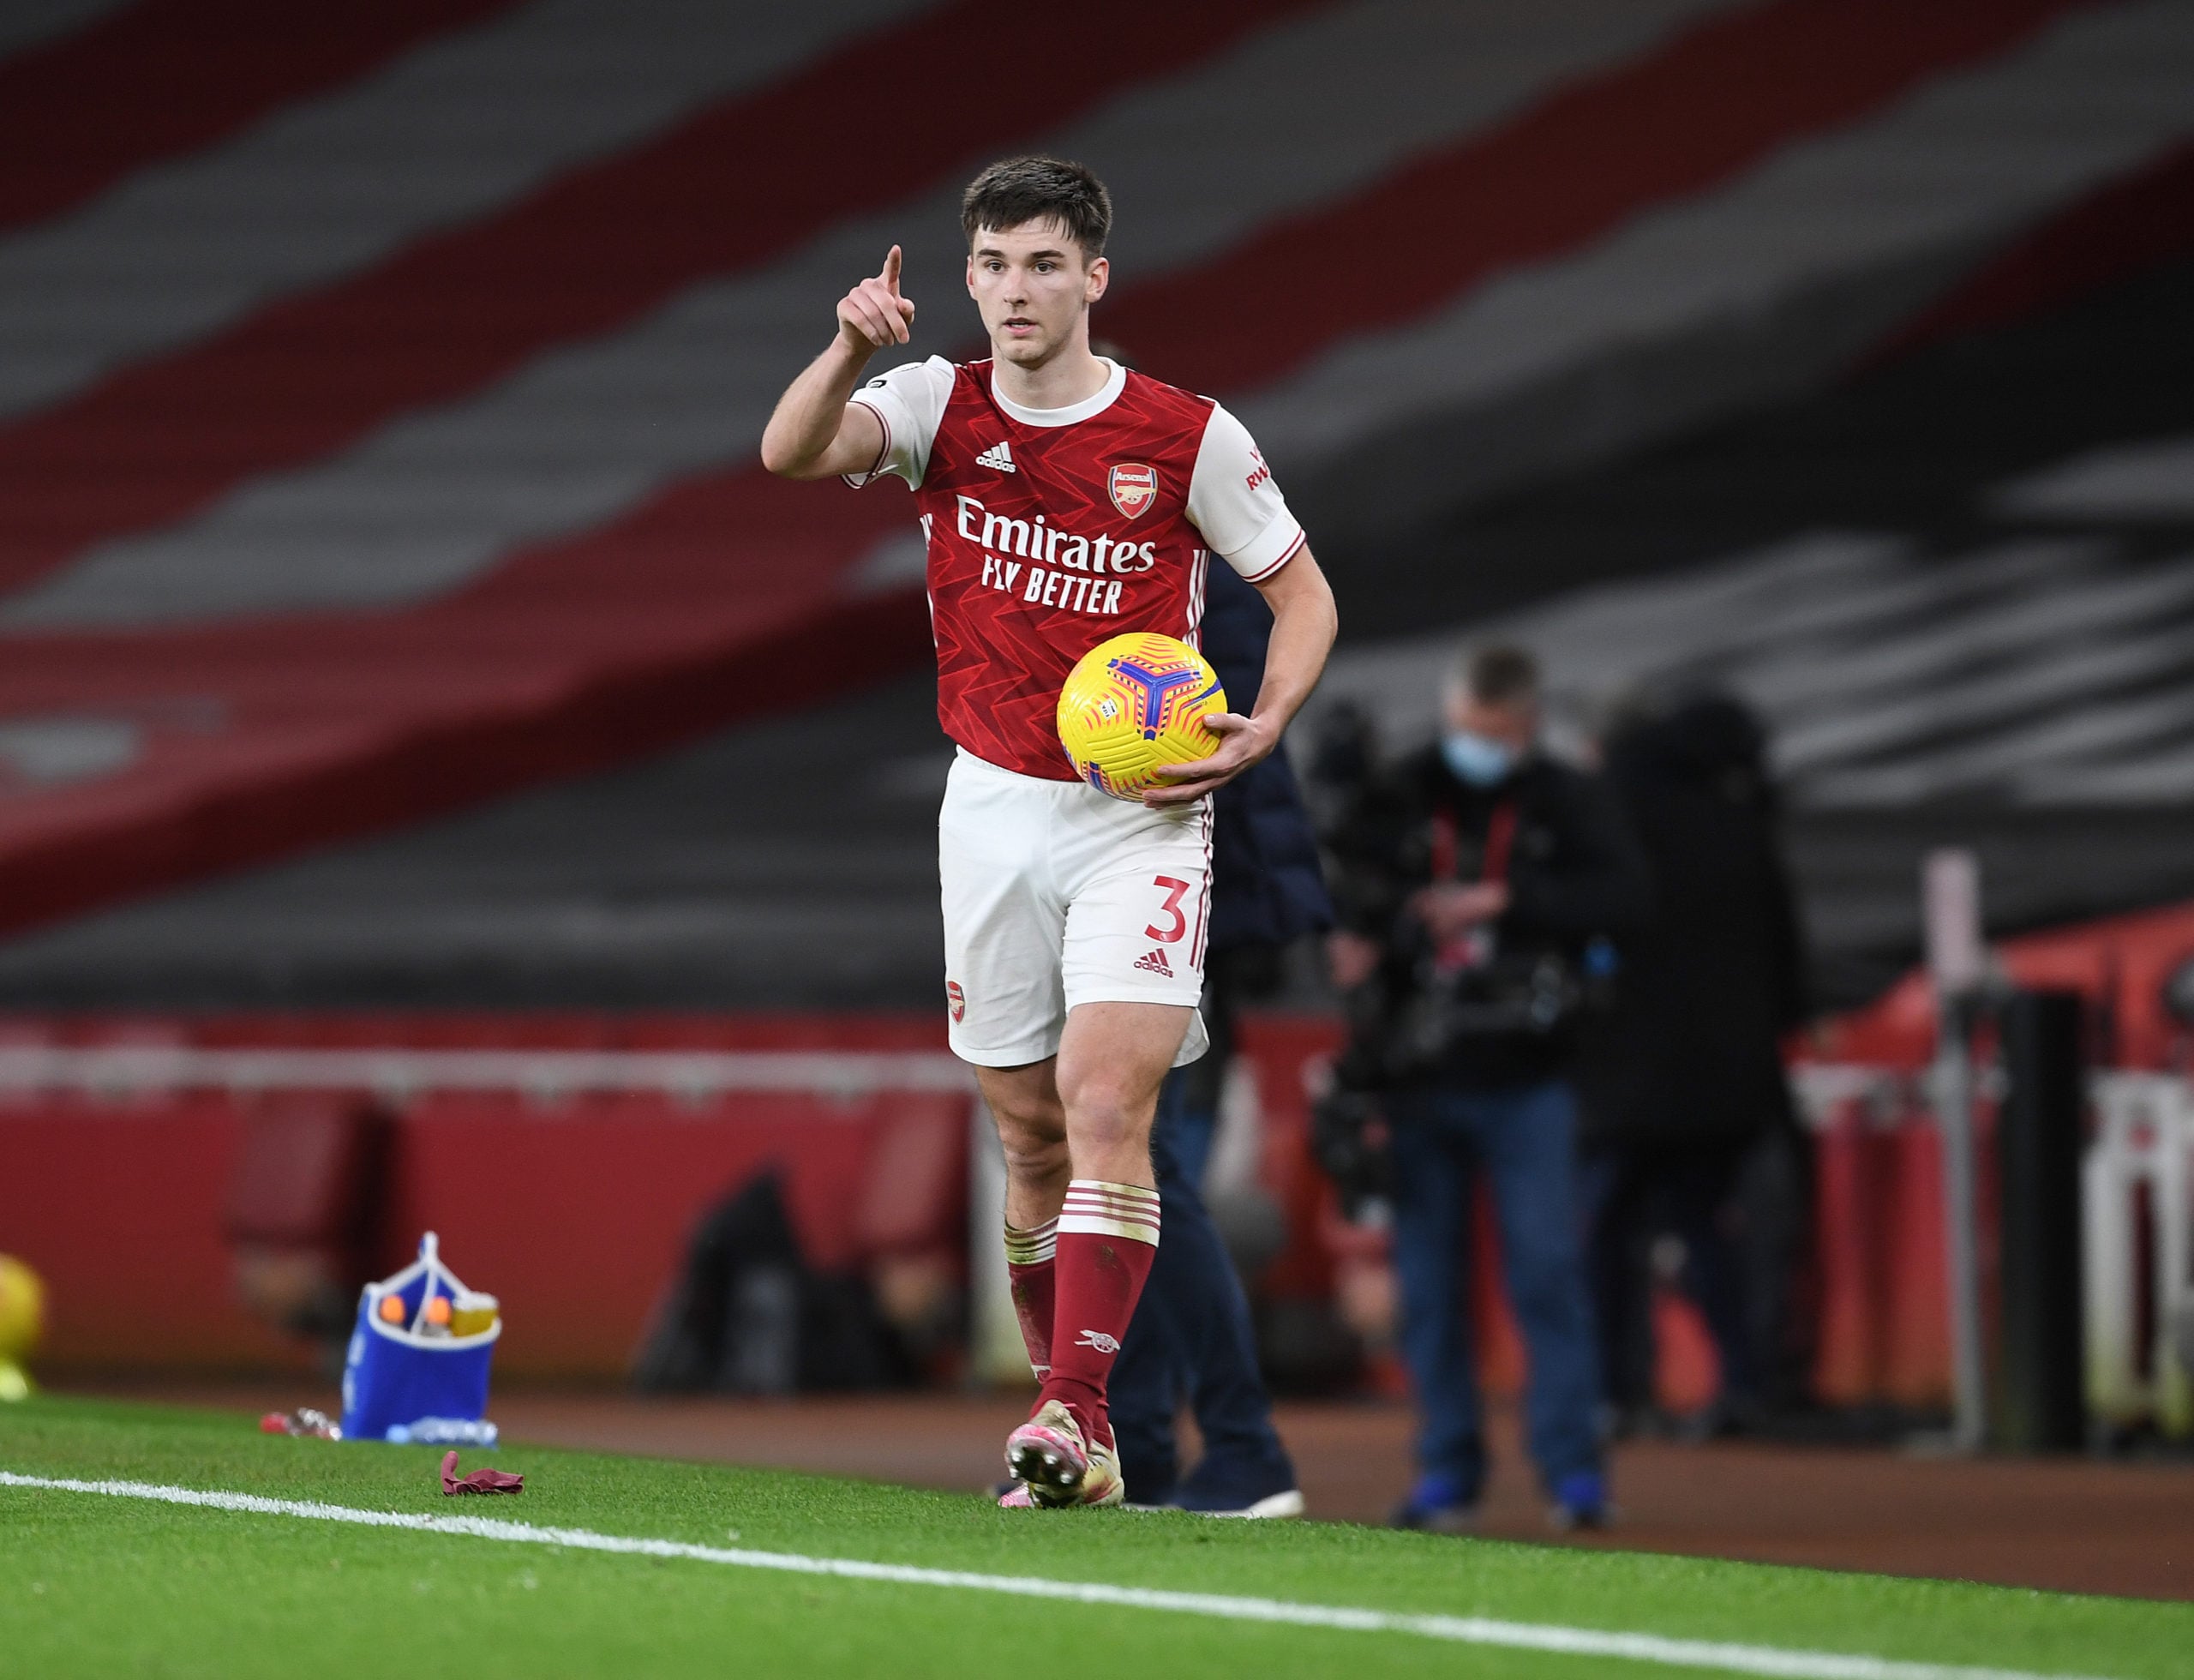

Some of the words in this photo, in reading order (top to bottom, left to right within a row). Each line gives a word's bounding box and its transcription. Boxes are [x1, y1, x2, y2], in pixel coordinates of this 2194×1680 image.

[975, 456, 1016, 472] adidas
[1115, 471, 1150, 483] Arsenal
[956, 495, 1155, 573] Emirates
[981, 554, 1022, 593] FLY
[1023, 567, 1123, 614] BETTER
[1144, 874, 1190, 943] 3
[1133, 960, 1174, 978] adidas
